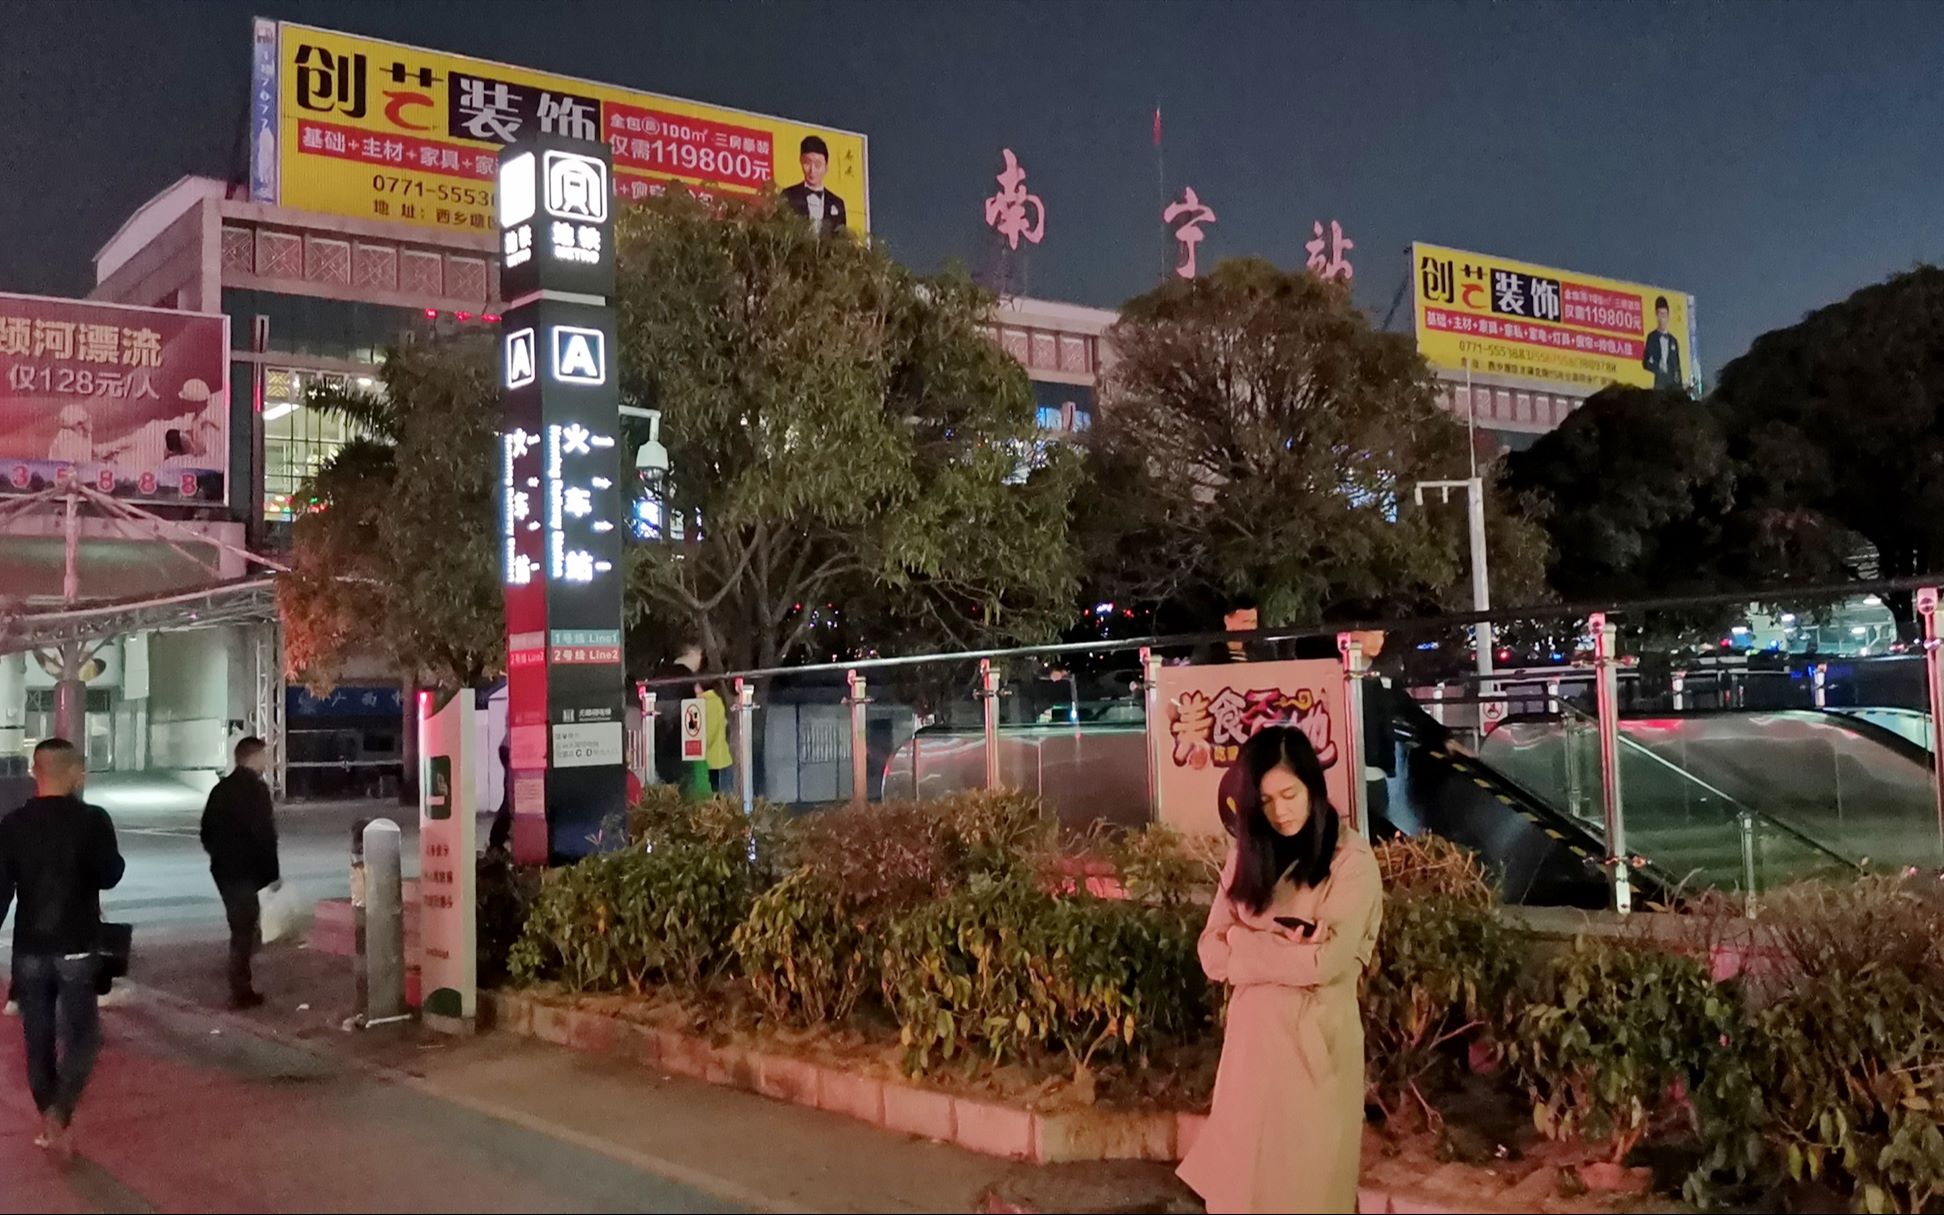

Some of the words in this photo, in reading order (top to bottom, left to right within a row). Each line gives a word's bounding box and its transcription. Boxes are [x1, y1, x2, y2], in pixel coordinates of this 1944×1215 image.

[295, 44, 596, 143] 创艺装饰
[609, 133, 771, 181] 仅需119800元
[373, 175, 494, 206] 0771-5553
[985, 148, 1354, 280] 南宁站
[1421, 256, 1560, 320] 创艺装饰
[511, 337, 532, 381] A
[561, 334, 598, 377] A
[9, 363, 160, 400] 仅128元/人
[589, 649, 619, 660] Line2
